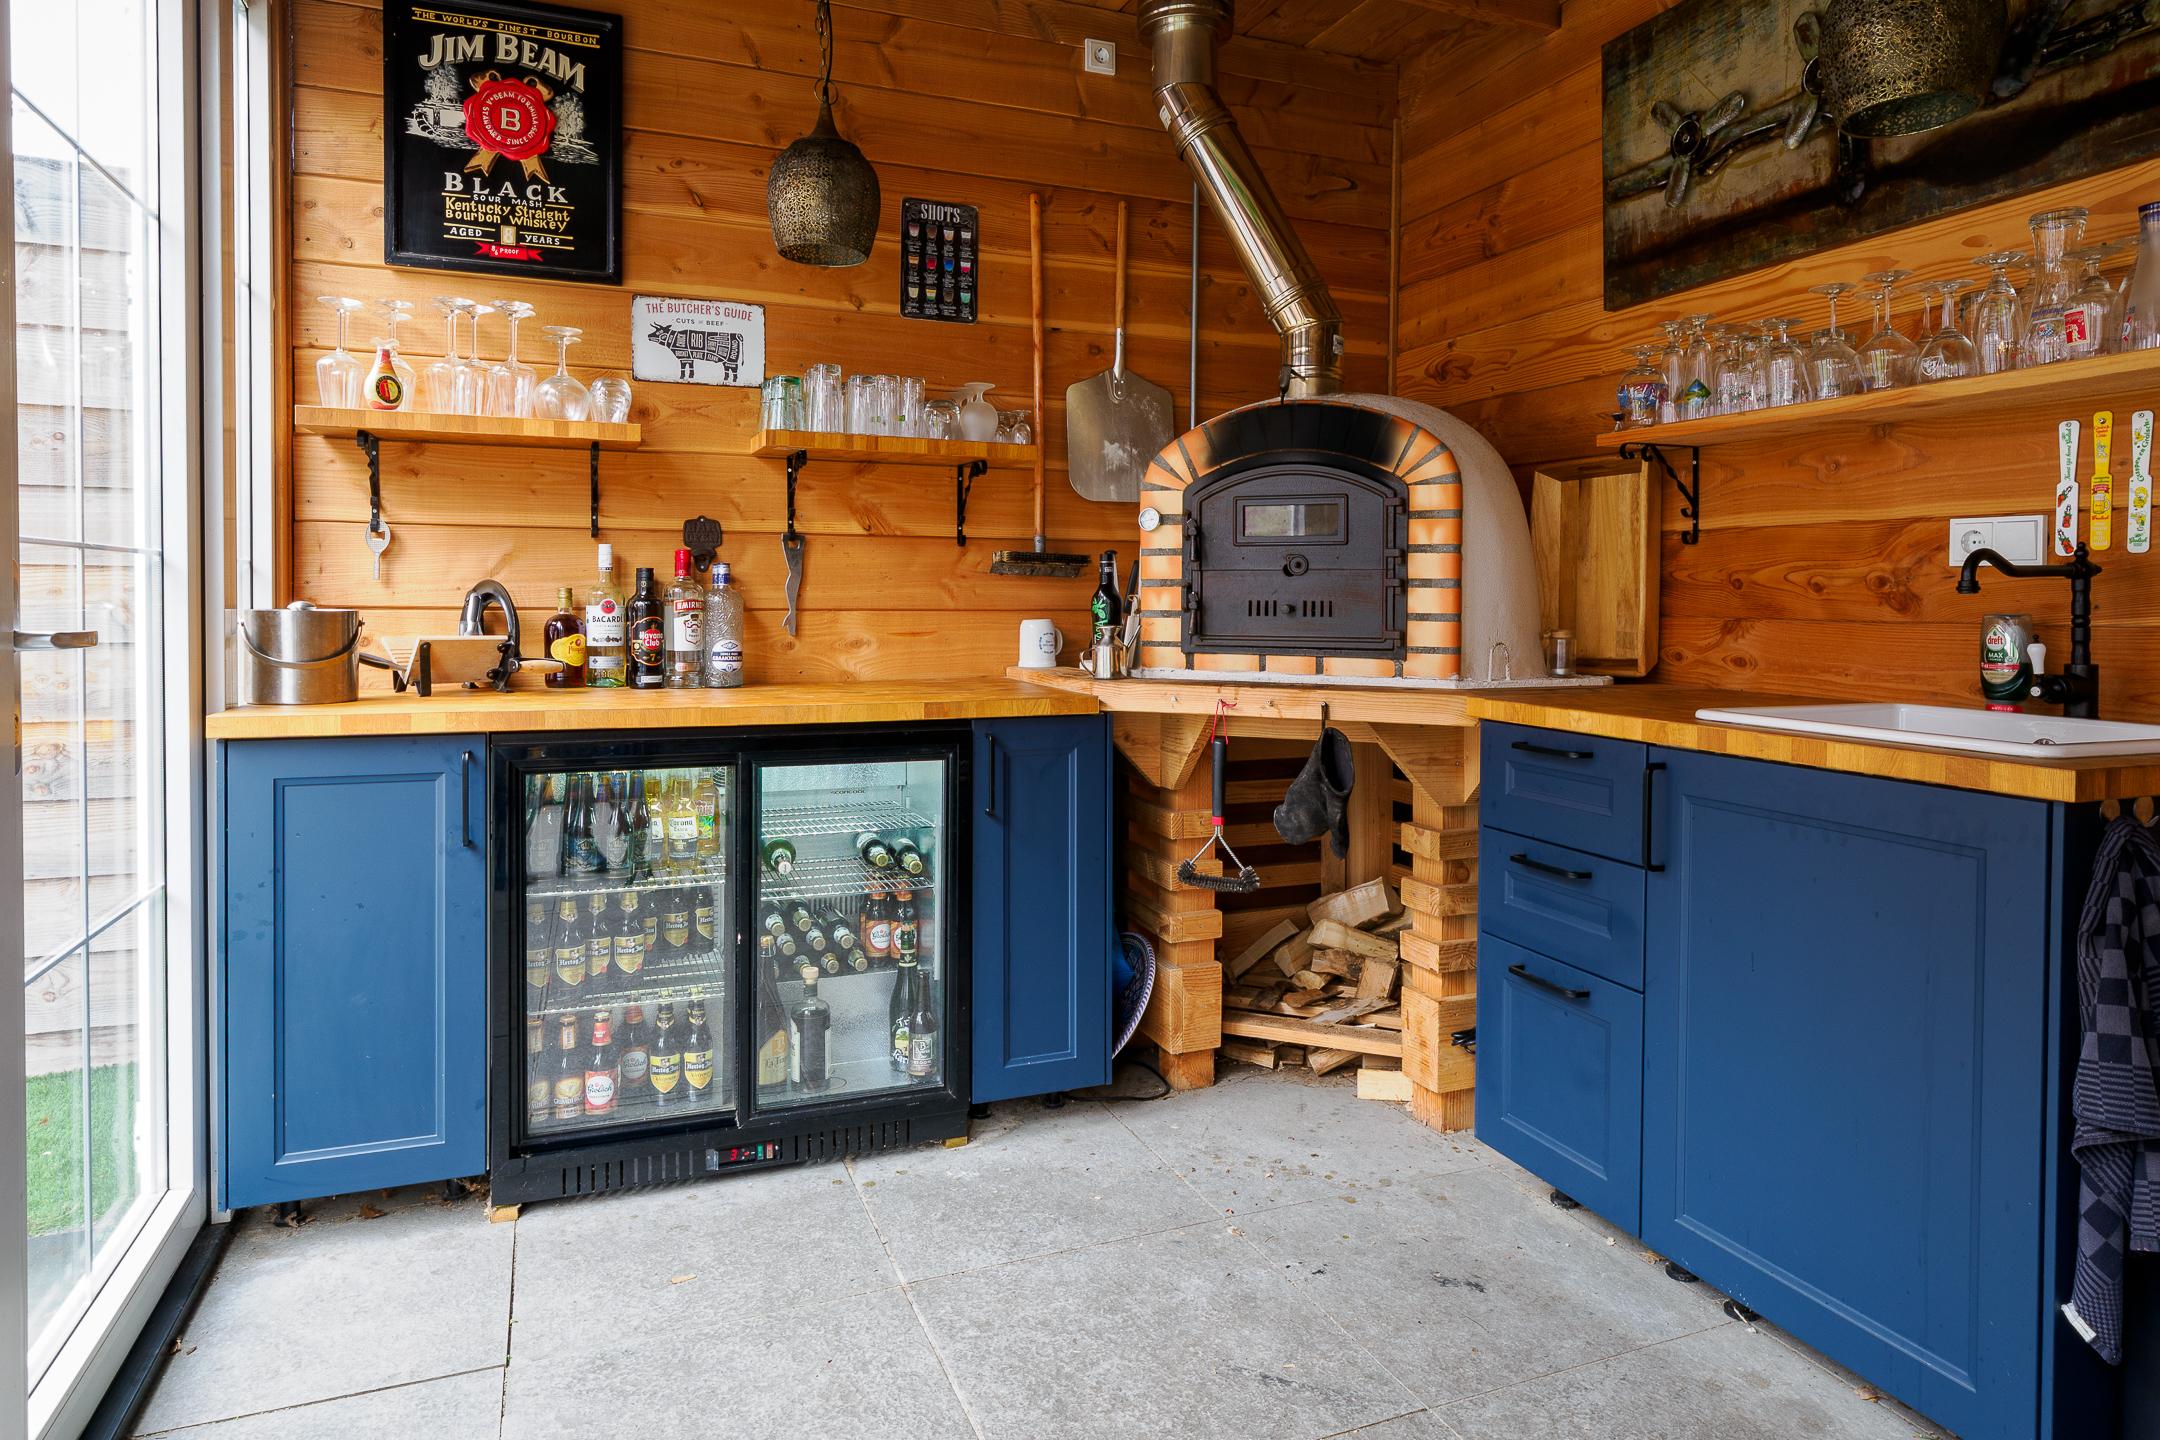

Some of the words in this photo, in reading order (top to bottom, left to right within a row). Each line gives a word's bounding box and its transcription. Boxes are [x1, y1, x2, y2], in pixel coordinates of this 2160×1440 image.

[415, 10, 436, 20] THE
[442, 14, 489, 28] WORLD'S
[498, 23, 538, 36] FINEST
[546, 30, 597, 45] BOURBON
[418, 33, 486, 71] JIM
[494, 32, 586, 93] BEAM
[493, 91, 515, 101] BEAM
[500, 107, 521, 132] B
[506, 136, 529, 145] SINCE
[444, 171, 568, 204] BLACK
[473, 194, 501, 204] SOUR
[511, 198, 542, 208] MASH
[445, 196, 511, 216] Kentucky
[515, 205, 570, 222] Straight
[920, 203, 961, 223] SHOTS
[445, 209, 501, 224] Bourbon
[450, 226, 483, 237] AGED
[524, 234, 560, 246] YEARS
[645, 302, 665, 314] THE
[667, 303, 721, 316] BUTCHER'S
[724, 307, 753, 321] GUIDE
[675, 317, 696, 325] CUTS
[690, 332, 704, 349] RIB
[730, 339, 739, 360] ROUND
[640, 631, 663, 640] Havana
[1987, 636, 2003, 645] dreft
[645, 639, 660, 647] Club
[669, 819, 693, 828] Corona
[616, 946, 634, 955] Hertog
[559, 957, 578, 967] Hertog
[587, 1084, 612, 1094] Grolsch
